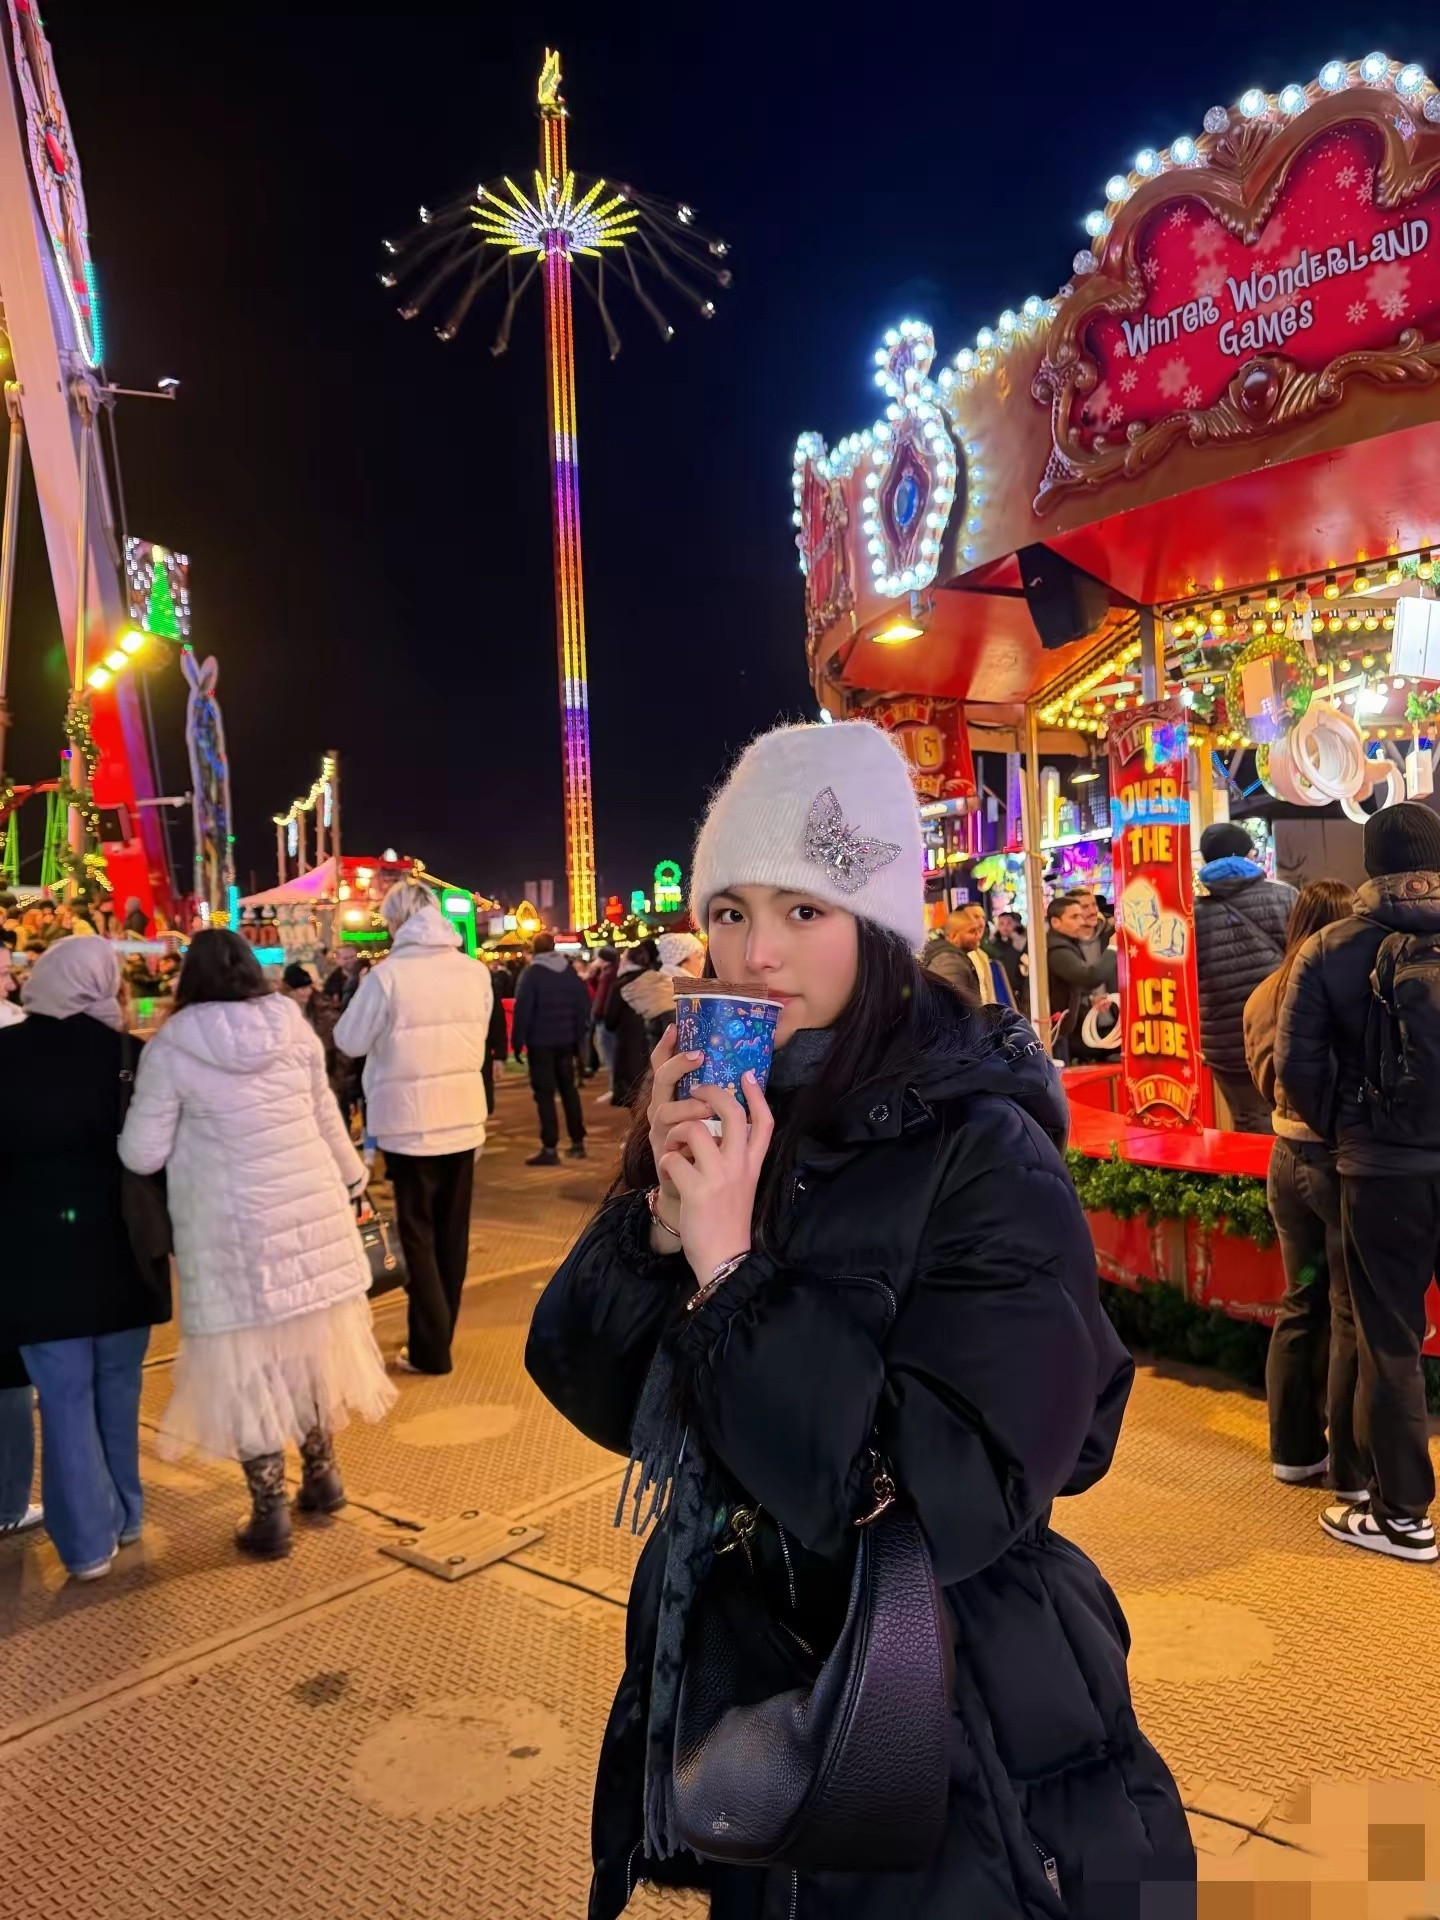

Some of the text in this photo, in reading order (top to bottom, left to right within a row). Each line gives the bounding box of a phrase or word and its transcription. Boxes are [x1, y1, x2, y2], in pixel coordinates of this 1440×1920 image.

[1121, 778, 1178, 820] OVER
[1128, 826, 1173, 865] THE
[1136, 977, 1177, 1017] ICE
[1131, 1020, 1189, 1059] CUBE
[1139, 1081, 1186, 1113] TO WIN
